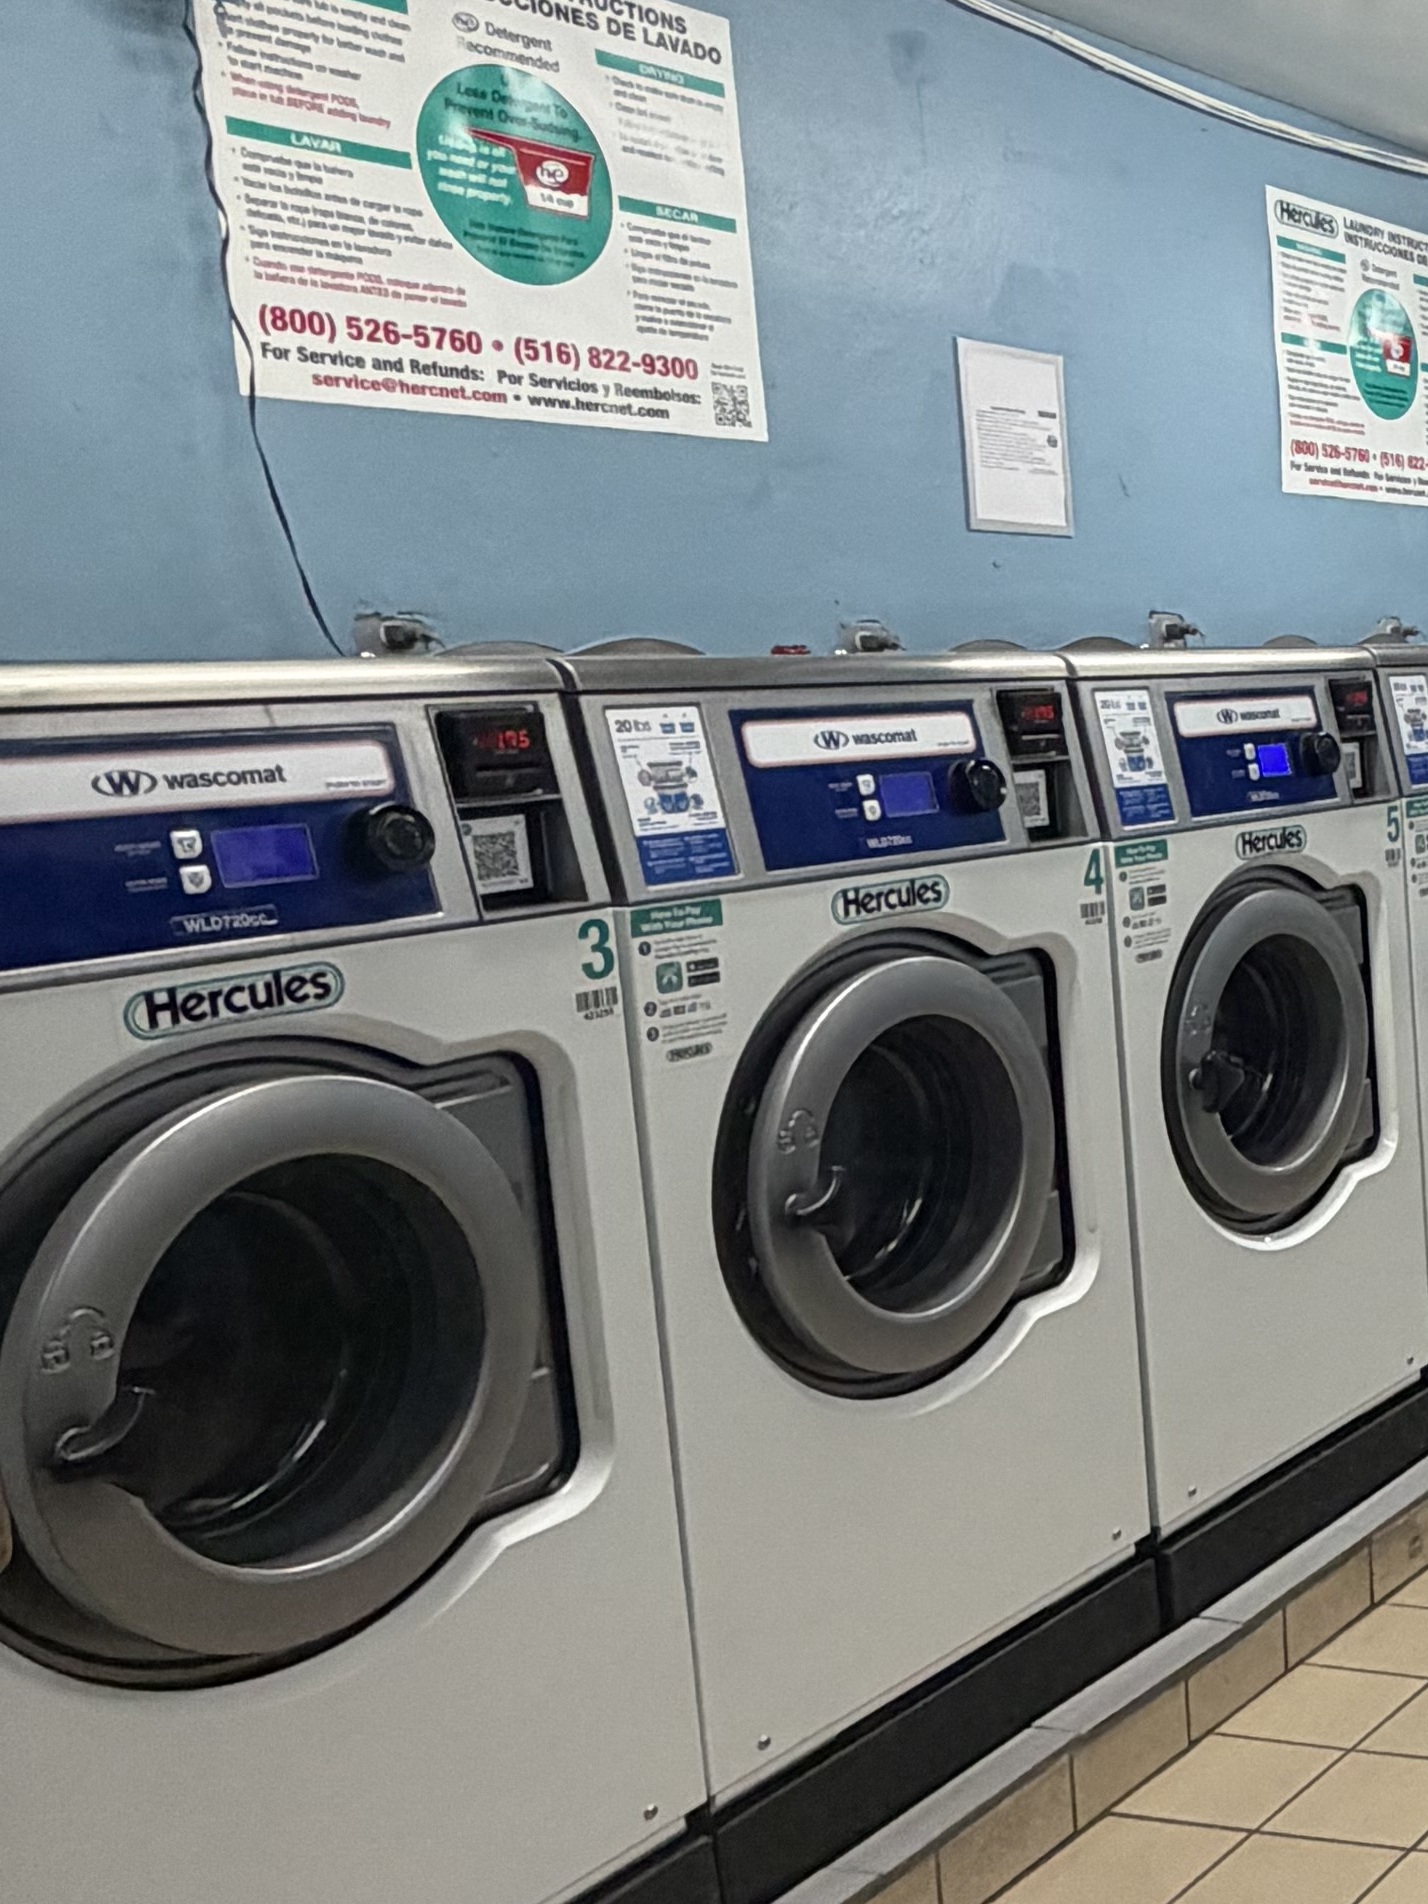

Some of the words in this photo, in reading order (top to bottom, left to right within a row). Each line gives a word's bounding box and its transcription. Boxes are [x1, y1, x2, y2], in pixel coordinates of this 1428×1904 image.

[485, 22, 552, 52] Detergent
[606, 16, 636, 41] DE
[644, 28, 722, 65] LAVADO
[457, 36, 560, 73] Recommended
[290, 133, 342, 153] LAVAR
[655, 206, 699, 225] SECAR
[1280, 202, 1334, 233] Hercules
[1343, 217, 1385, 239] LAUNDRY
[1344, 232, 1415, 262] INSTRUCCIONES
[259, 303, 337, 344] (800)
[345, 315, 484, 355] 526-5760
[514, 336, 581, 371] (516)
[588, 346, 698, 380] 822-9300
[260, 341, 291, 361] For
[297, 345, 366, 369] Service
[371, 357, 404, 373] and
[410, 359, 485, 381] Refunds:
[497, 369, 524, 386] Por
[529, 372, 598, 394] Servicios
[312, 373, 508, 404] service@hercnet.com
[527, 393, 670, 419] www.hercnet.com
[615, 719, 632, 733] 20
[1240, 709, 1280, 721] wascomat
[852, 729, 918, 745] wascomat
[163, 764, 287, 790] wascomat
[1387, 806, 1400, 842] 5
[1241, 827, 1301, 856] Hercules
[1084, 848, 1103, 894] 4
[843, 880, 942, 918] Hercules
[578, 918, 614, 979] 3
[144, 969, 331, 1030] Hercules
